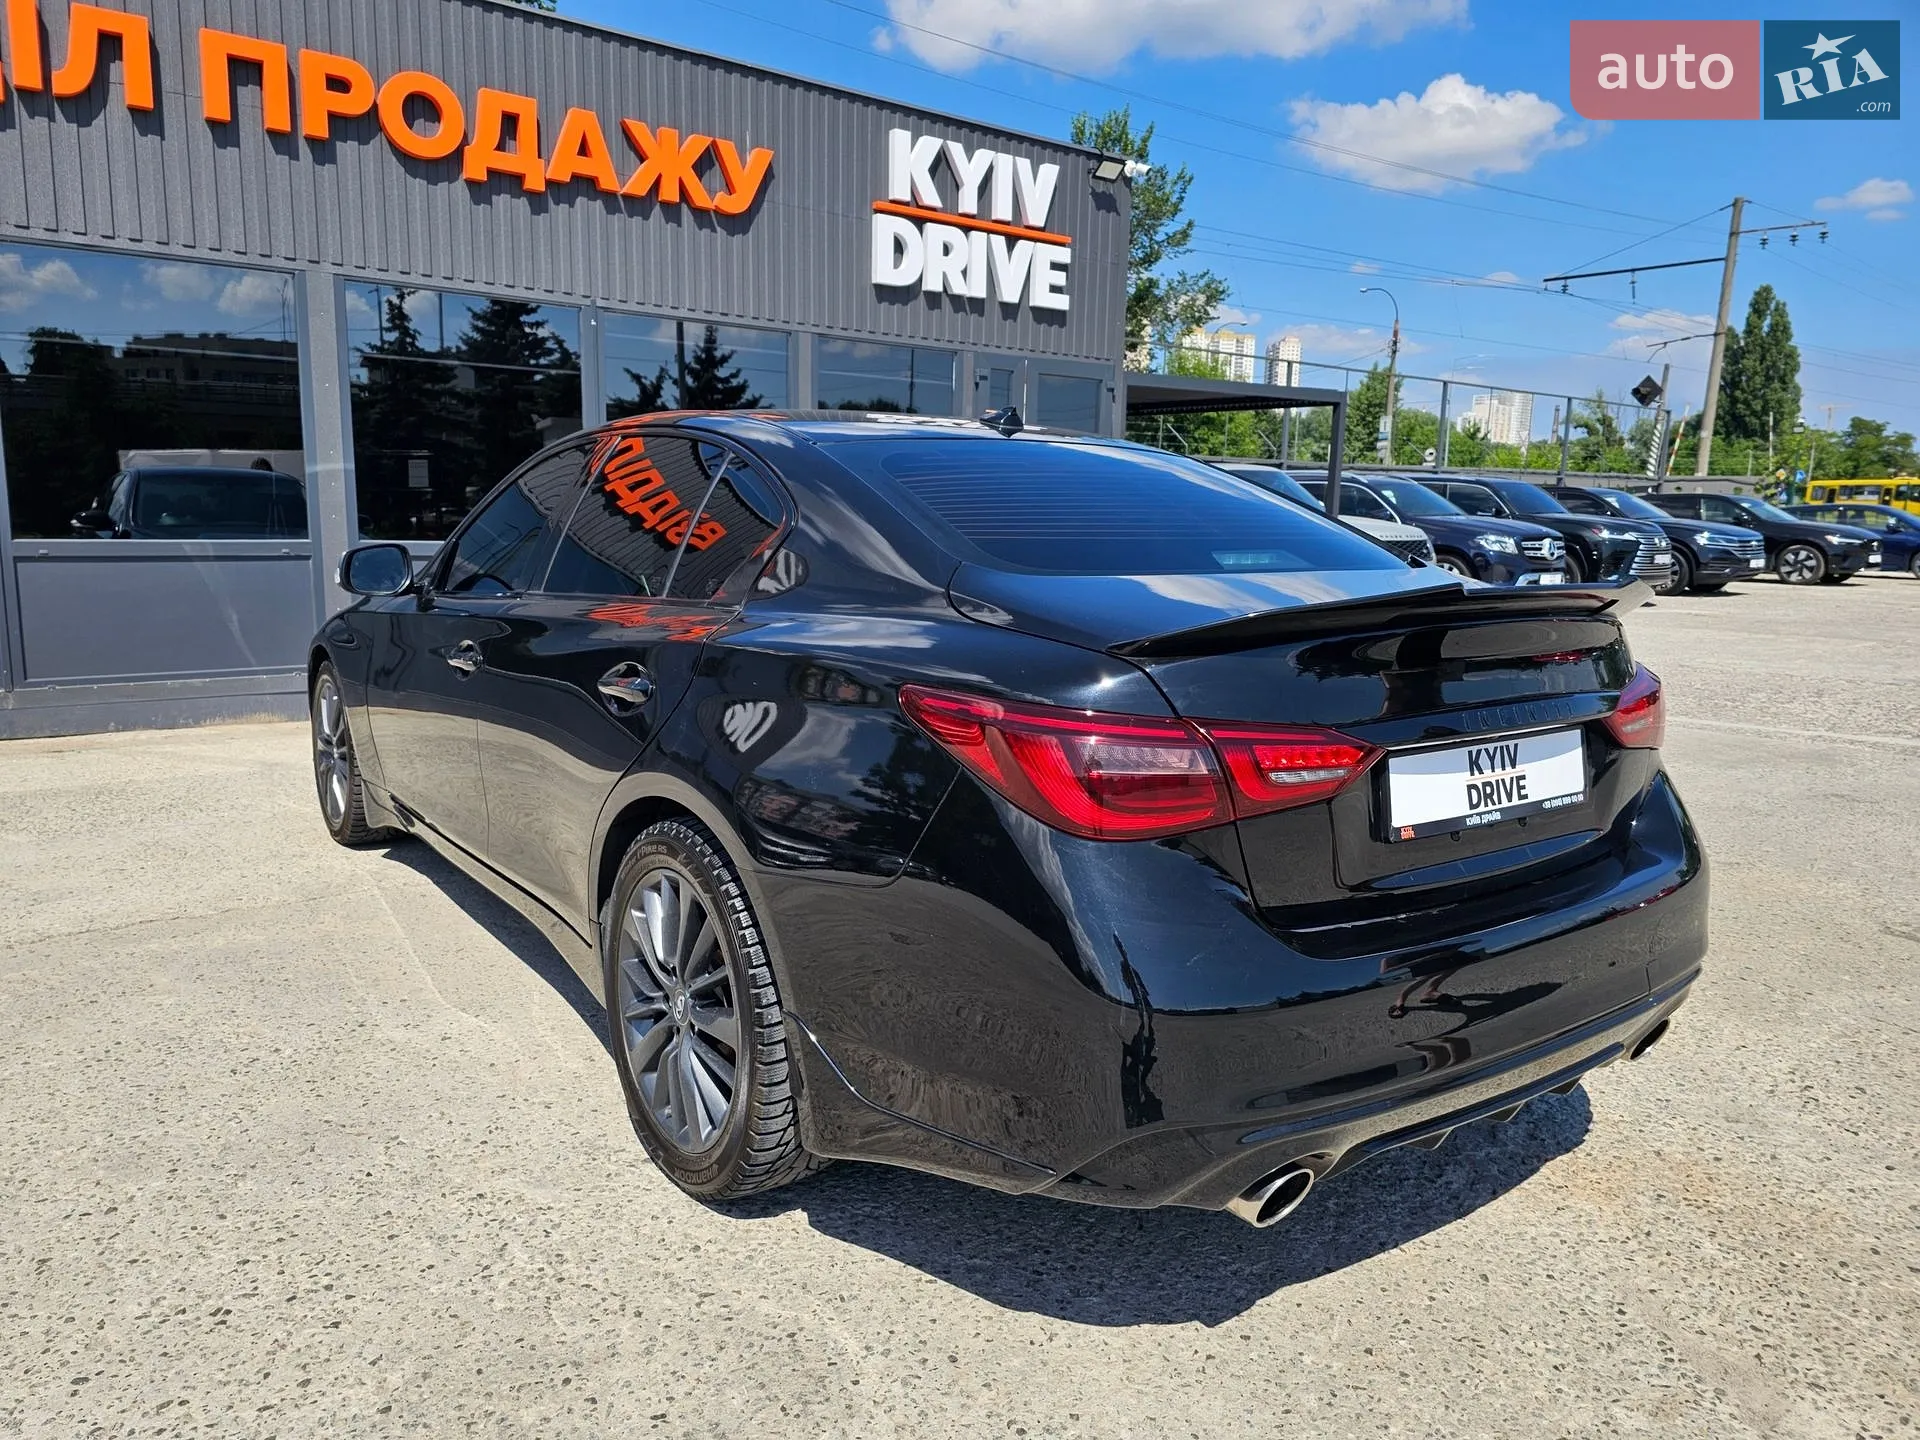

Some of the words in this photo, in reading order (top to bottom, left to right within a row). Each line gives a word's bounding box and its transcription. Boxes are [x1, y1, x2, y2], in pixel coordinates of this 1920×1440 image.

[199, 27, 775, 216] ПРОДАЖУ
[888, 128, 1060, 230] KYIV
[872, 212, 1072, 312] DRIVE
[1466, 774, 1529, 811] DRIVE
[1467, 742, 1519, 777] KYIV
